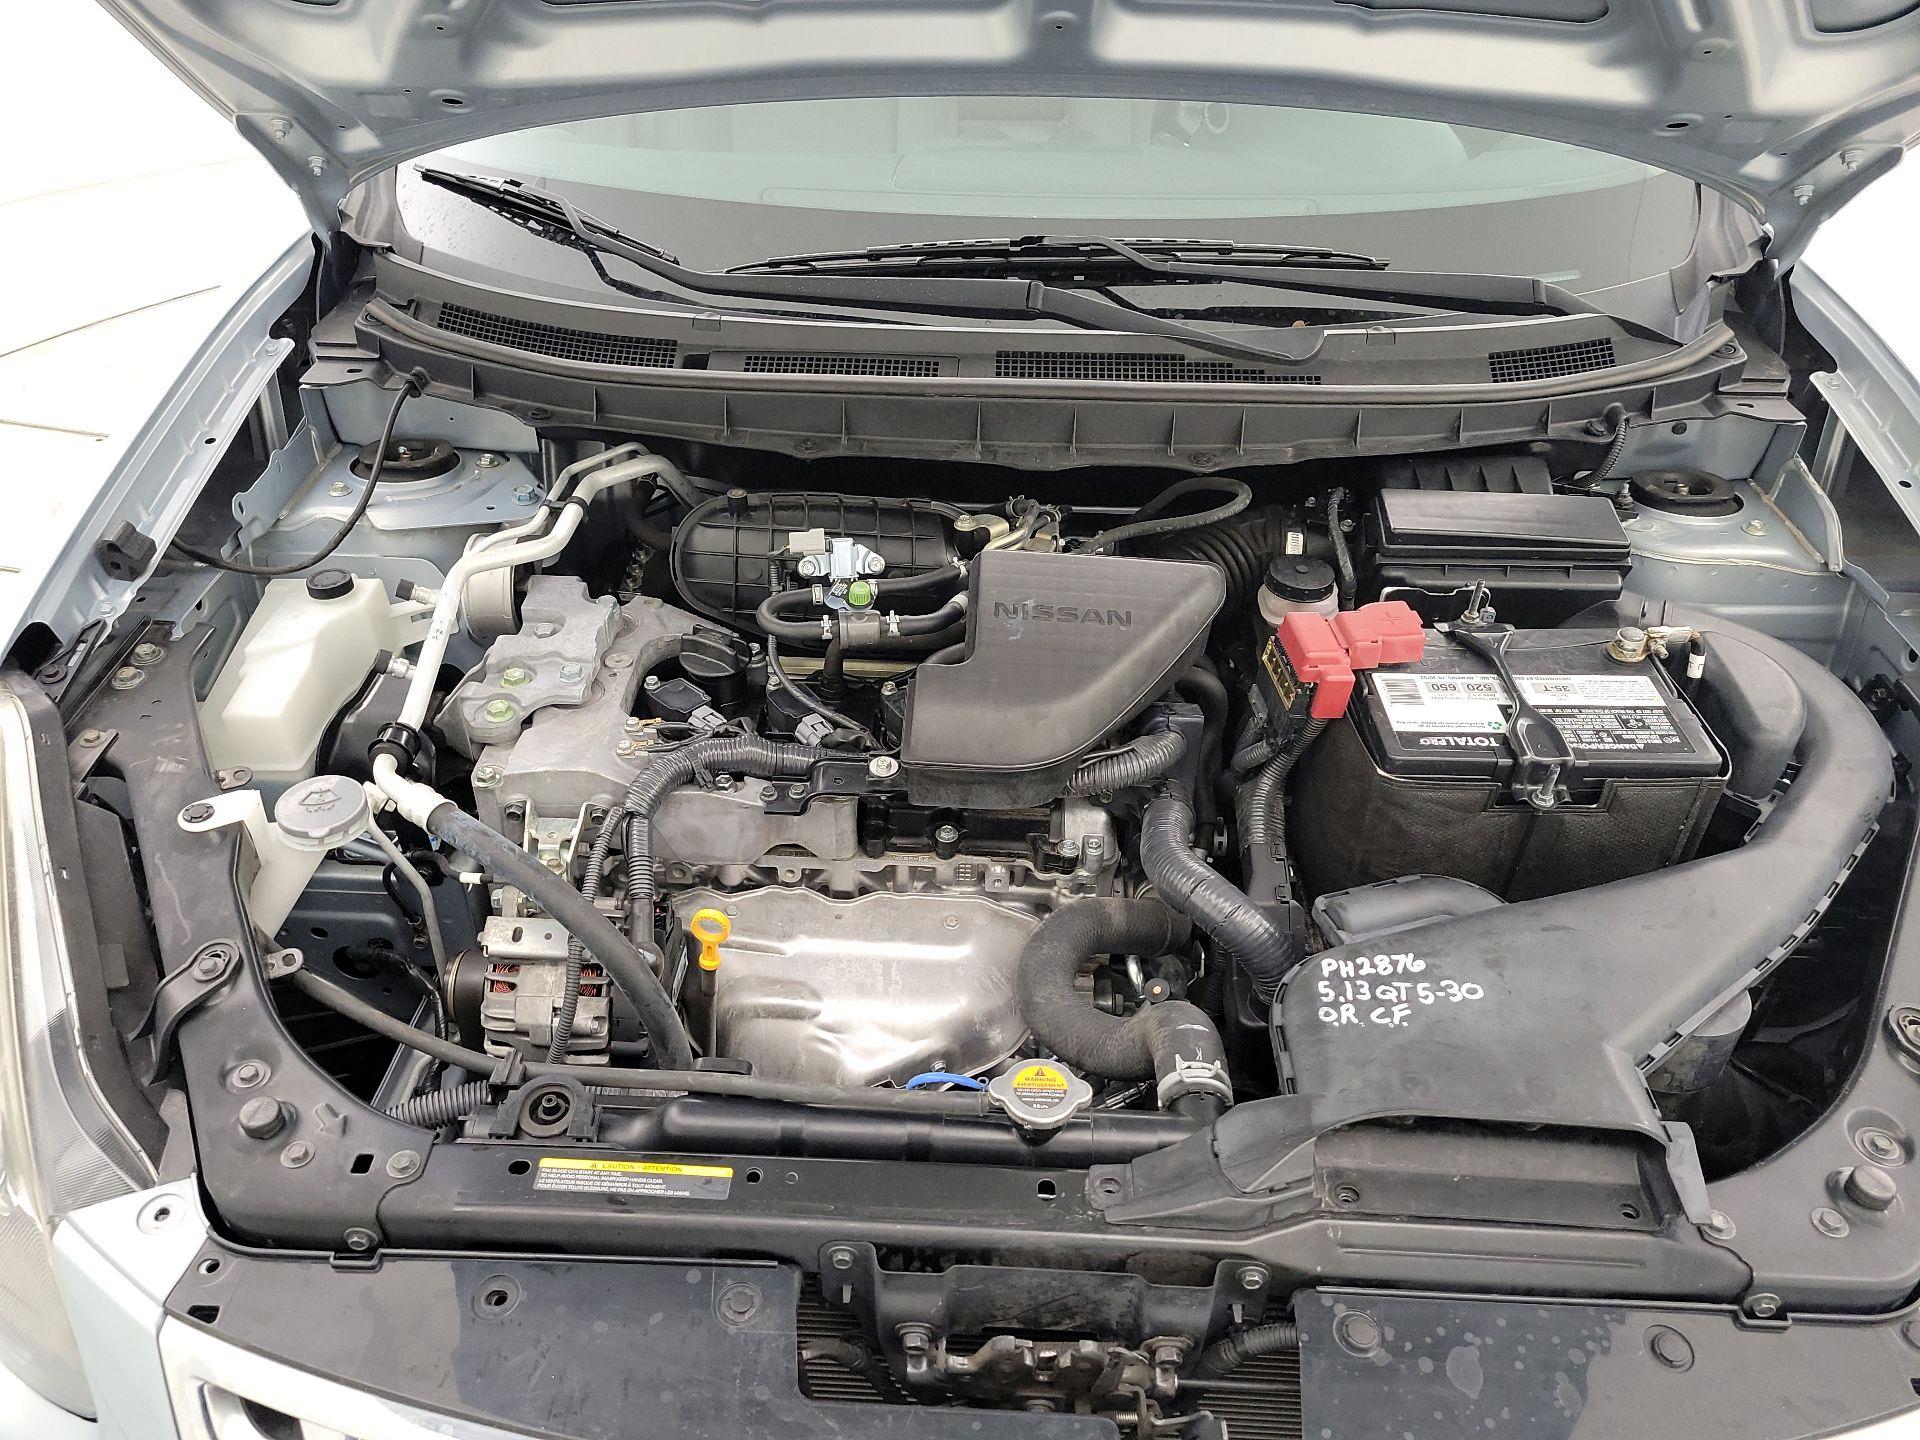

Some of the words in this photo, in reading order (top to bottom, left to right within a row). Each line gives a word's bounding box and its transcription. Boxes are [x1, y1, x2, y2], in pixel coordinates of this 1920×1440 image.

[994, 601, 1133, 627] NISSAN
[1432, 683, 1457, 692] 650
[1467, 683, 1492, 692] 520
[1543, 684, 1571, 692] 35-T
[1320, 953, 1427, 978] PH2876
[1375, 981, 1414, 1003] QT
[1416, 980, 1485, 1004] 5-30
